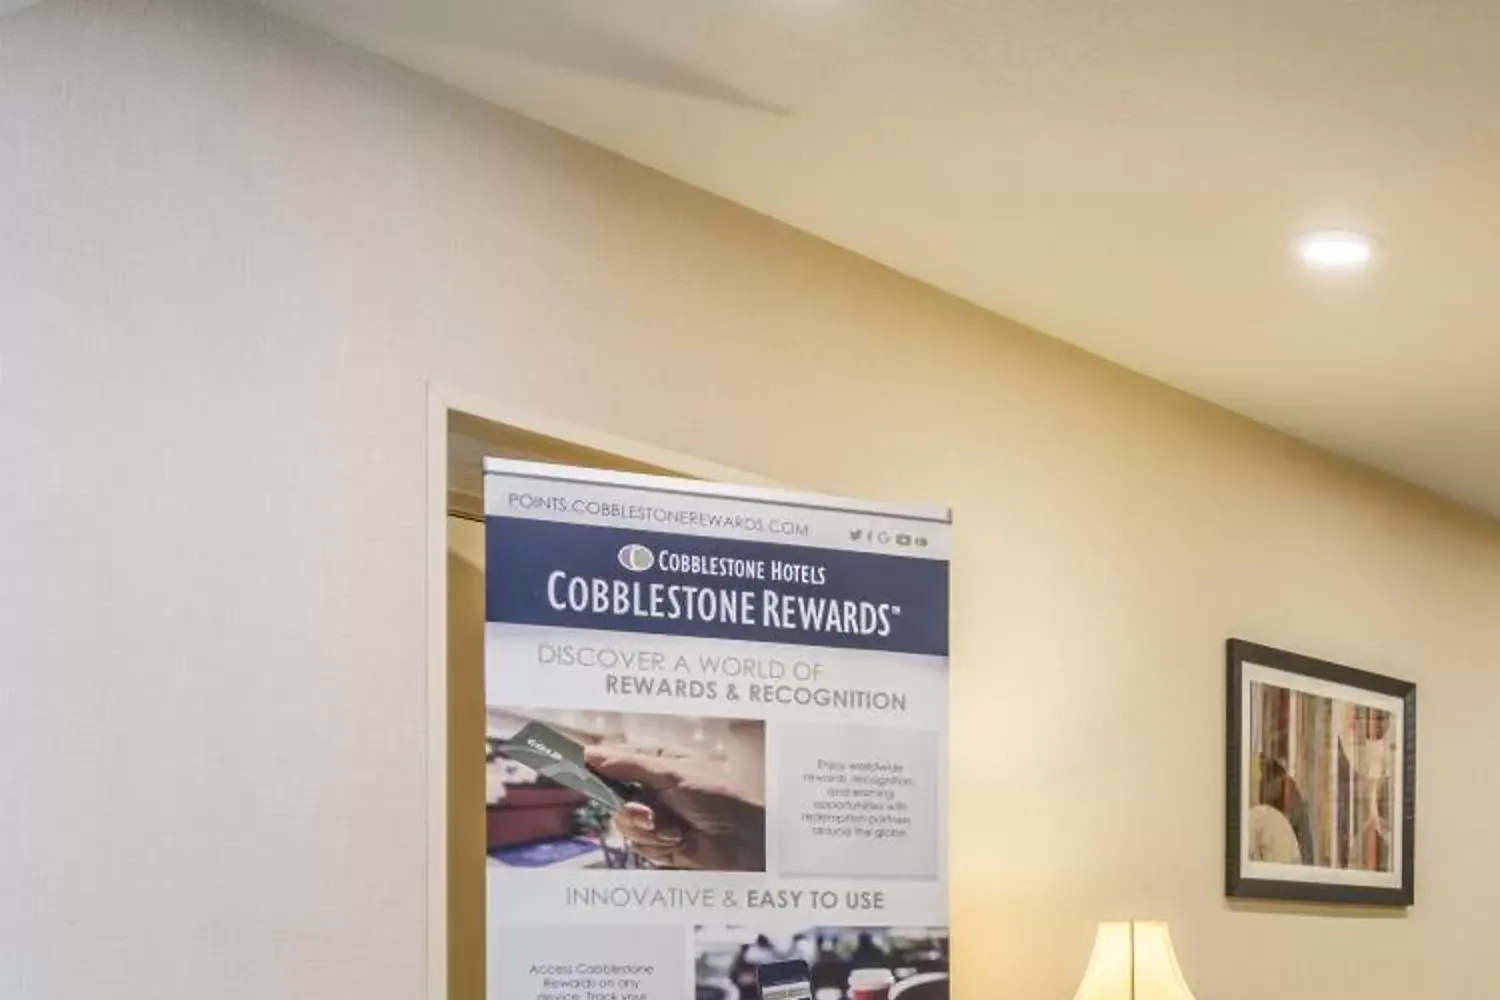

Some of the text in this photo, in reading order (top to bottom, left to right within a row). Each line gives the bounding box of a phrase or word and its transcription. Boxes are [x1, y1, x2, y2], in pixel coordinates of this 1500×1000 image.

[508, 493, 808, 537] POINTS.COBBLESTONEREWARDS.COM
[659, 549, 826, 585] COBBLESTONE HOTELS
[547, 569, 756, 626] COBBLESTONE
[538, 643, 824, 682] DISCOVER A WORLD OF
[605, 674, 907, 712] REWARDS & RECOGNITION
[565, 886, 884, 910] INNOVATIVE & EASY TO USE
